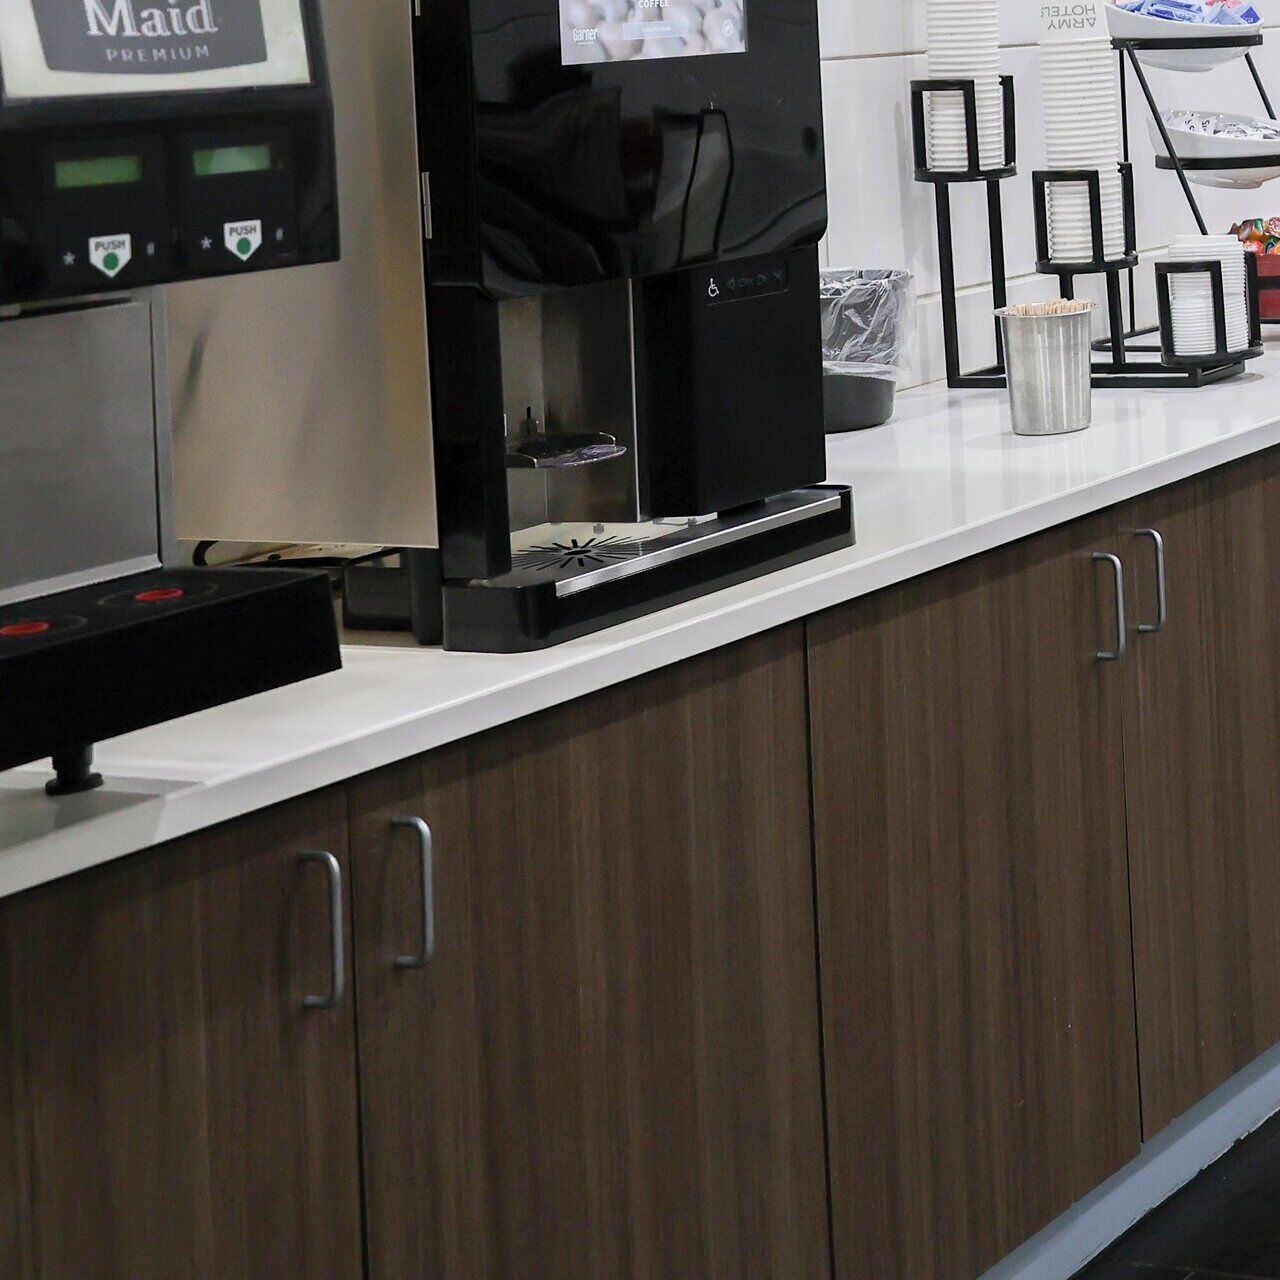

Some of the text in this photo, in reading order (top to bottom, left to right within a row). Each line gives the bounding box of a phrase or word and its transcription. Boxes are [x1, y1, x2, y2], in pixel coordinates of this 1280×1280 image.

[1049, 17, 1097, 31] ARMY
[105, 45, 210, 62] PREMIUM
[229, 224, 257, 237] PUSH
[94, 239, 126, 252] PUSH
